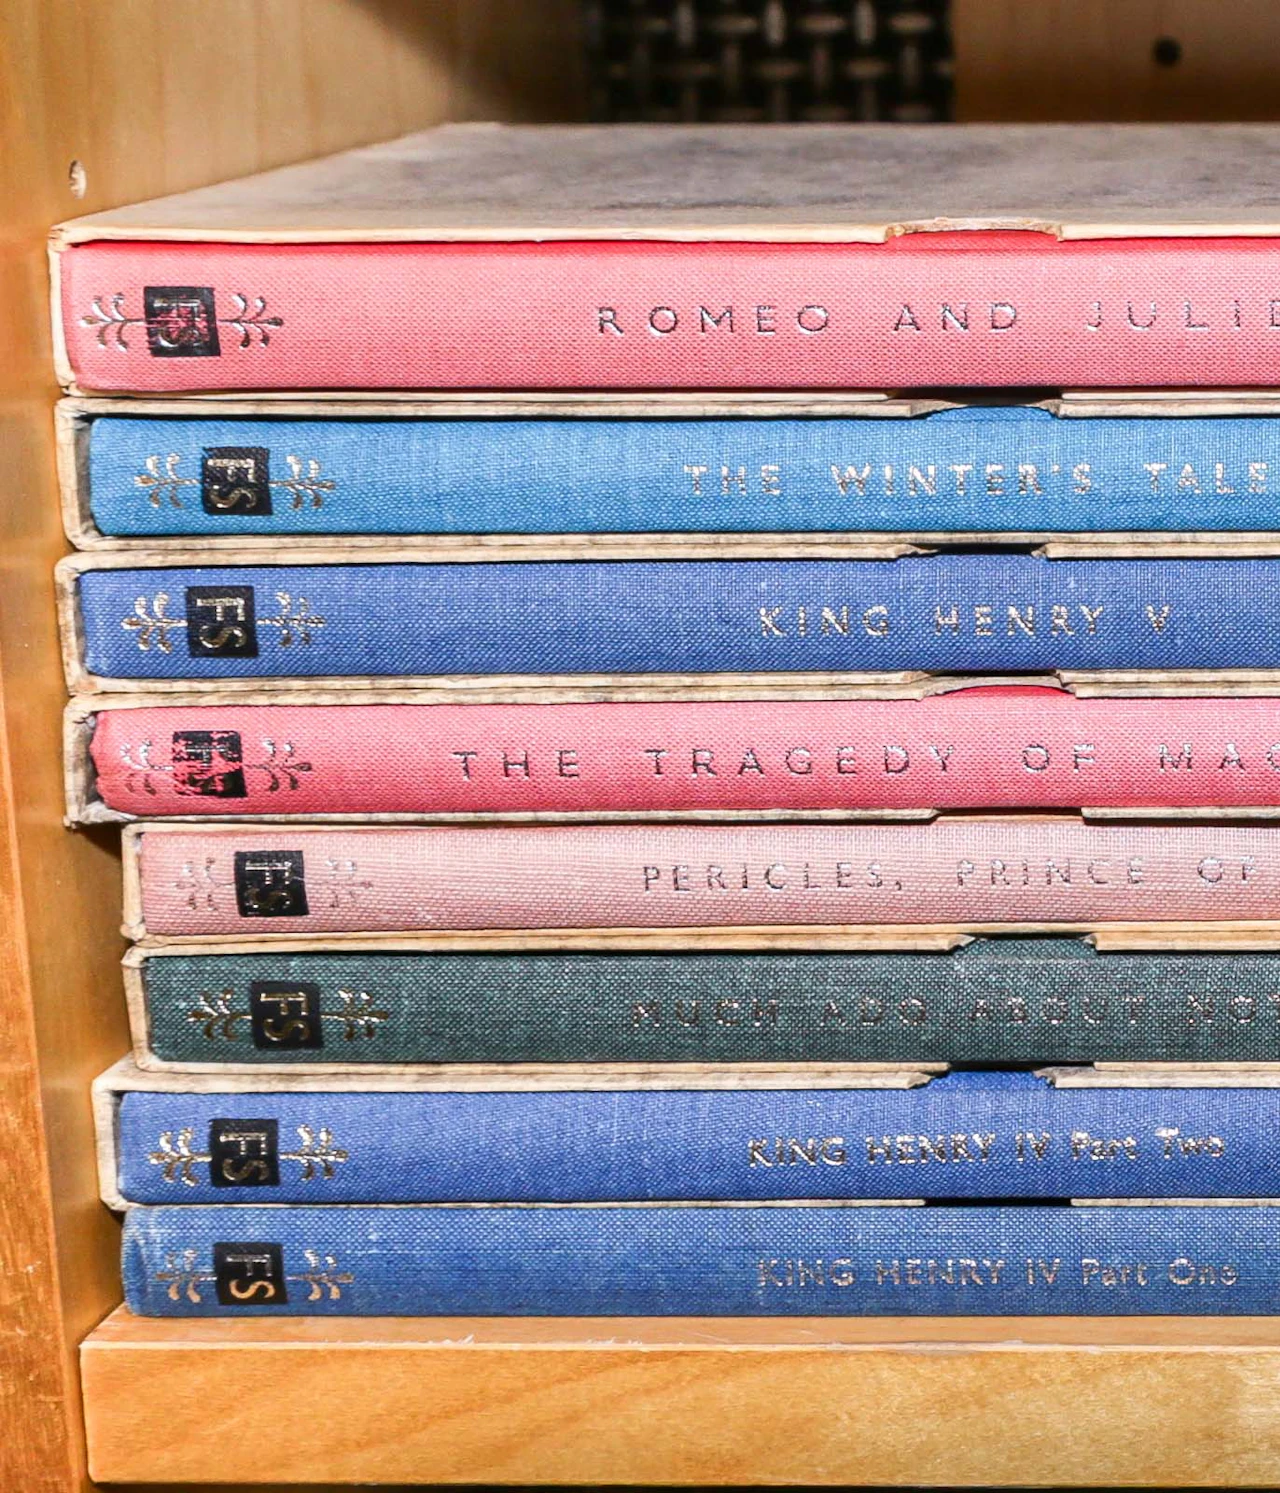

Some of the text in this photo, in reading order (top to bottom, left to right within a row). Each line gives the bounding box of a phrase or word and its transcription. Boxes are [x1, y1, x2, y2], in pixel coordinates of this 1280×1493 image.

[598, 305, 829, 335] ROMEO
[892, 303, 1017, 332] AND
[205, 457, 257, 511] FS
[683, 462, 1268, 495] THE WINTER'S TALE
[196, 597, 247, 650] FS
[759, 605, 1171, 637] KING HENRY V
[452, 750, 580, 780] THE
[644, 745, 955, 777] TRAGEDY
[1022, 744, 1097, 772] OF
[243, 859, 293, 912] FS
[644, 862, 903, 892] PERICLES,
[957, 860, 1144, 886] PRINCE
[1197, 855, 1255, 884] OF
[258, 990, 311, 1043] FS
[219, 1131, 269, 1183] FS
[749, 1127, 1224, 1168] KING HENRY IV Part Two
[225, 1252, 276, 1302] FS
[757, 1258, 1238, 1288] KING HENRY IV Part One
